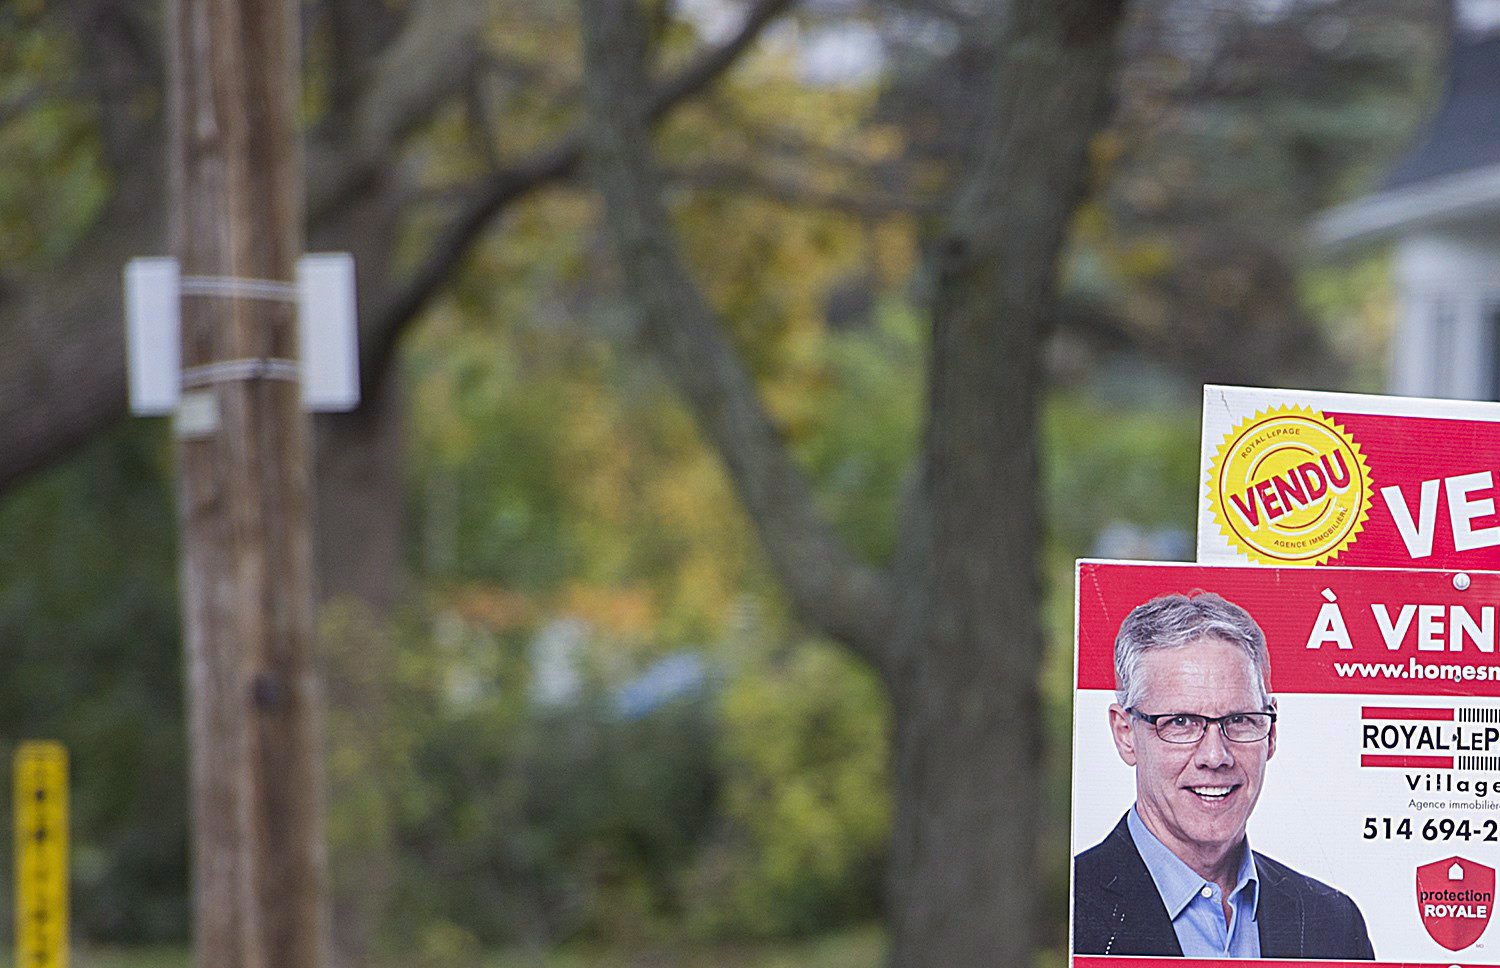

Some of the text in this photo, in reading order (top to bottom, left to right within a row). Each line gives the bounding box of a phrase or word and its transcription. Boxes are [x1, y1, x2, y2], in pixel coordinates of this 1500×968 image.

[1241, 436, 1265, 459] ROYAL
[1230, 448, 1351, 527] VENDU
[1273, 539, 1308, 549] AGENCE
[1306, 587, 1353, 649] À
[1361, 724, 1450, 750] ROYAL
[1408, 798, 1446, 811] Agence
[1362, 817, 1413, 840] 514
[1419, 889, 1491, 904] protection
[1423, 904, 1488, 919] ROYALE
